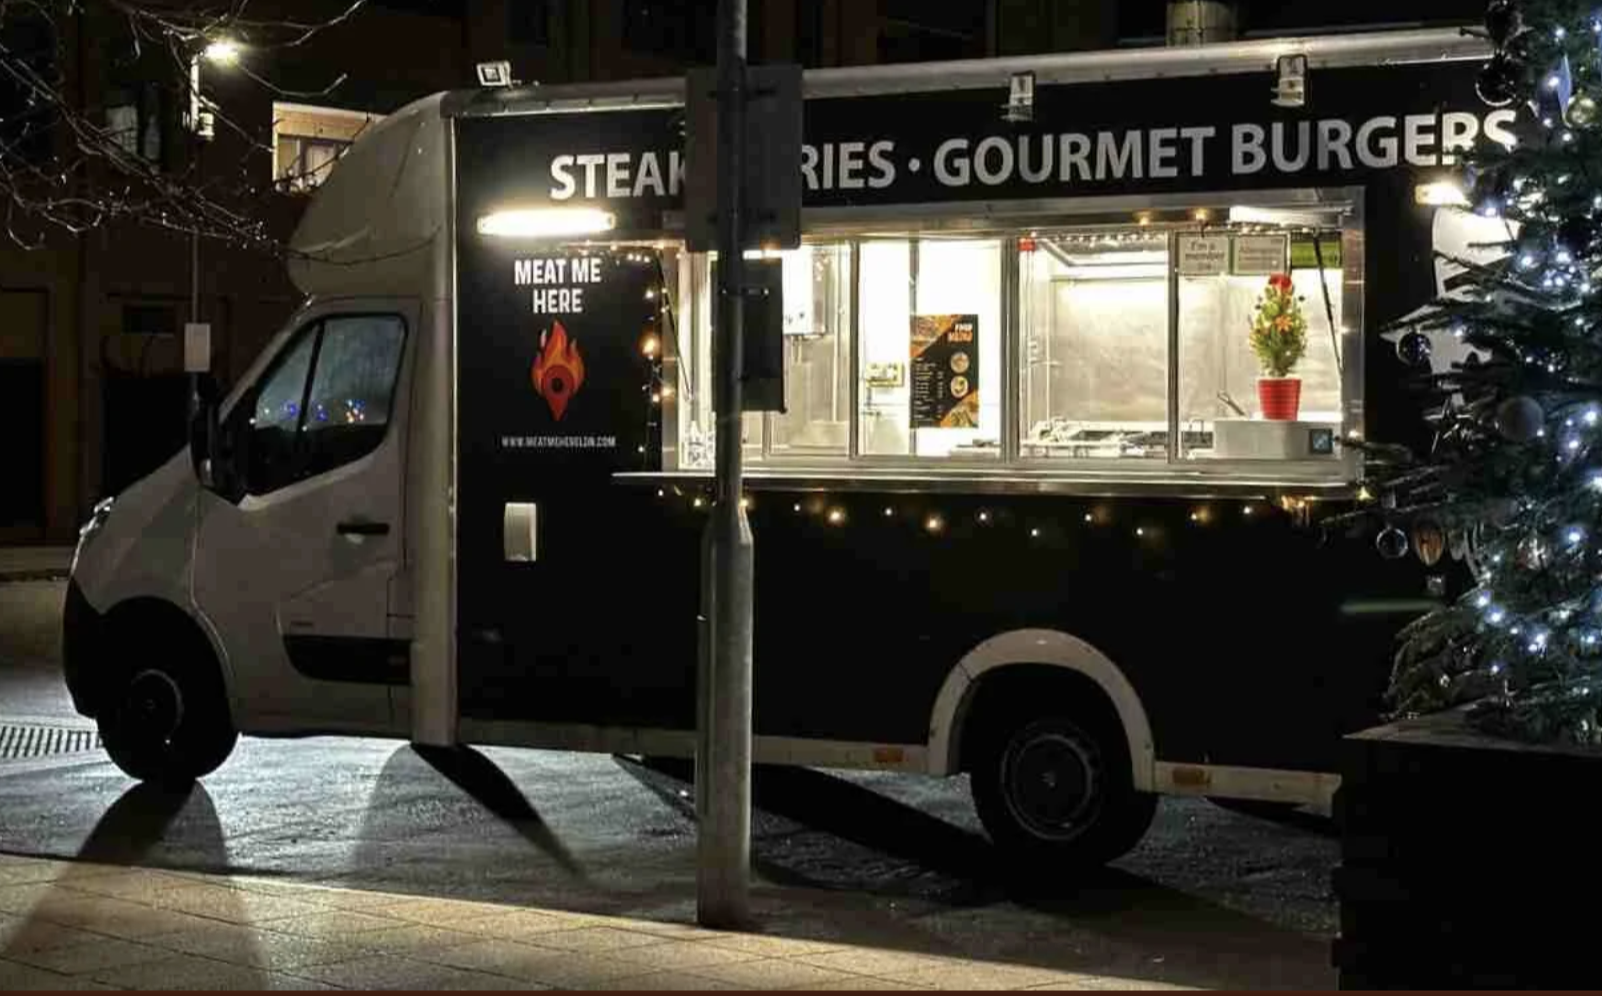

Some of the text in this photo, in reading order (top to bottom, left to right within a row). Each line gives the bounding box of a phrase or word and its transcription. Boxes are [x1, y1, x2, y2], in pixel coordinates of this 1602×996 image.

[800, 141, 896, 190] RIES
[933, 126, 1215, 186] GOURMET
[1231, 108, 1519, 174] BURGERS
[514, 257, 602, 286] MEAT ME
[532, 288, 583, 314] HERE
